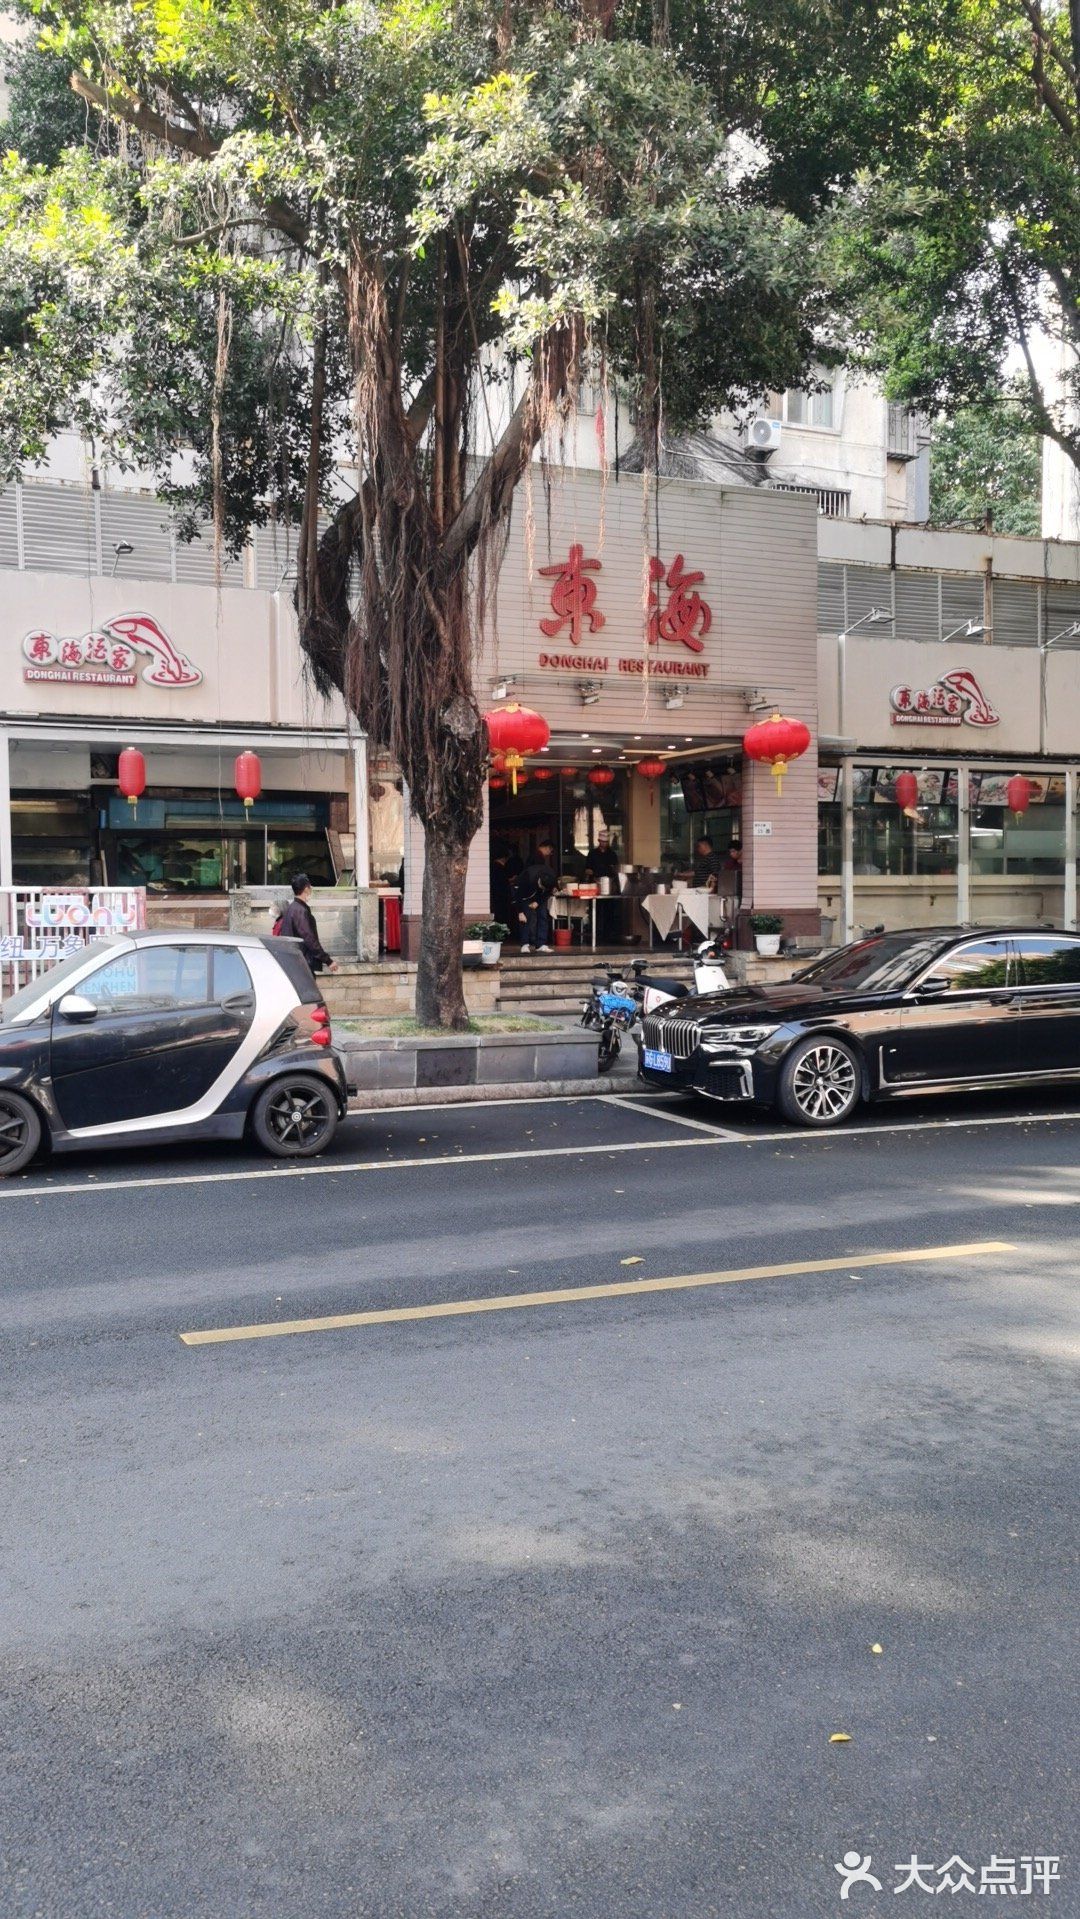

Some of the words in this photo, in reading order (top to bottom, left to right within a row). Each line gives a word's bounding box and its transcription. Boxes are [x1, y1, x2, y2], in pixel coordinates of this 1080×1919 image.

[539, 653, 609, 671] DONGHAI
[618, 657, 711, 677] RESTAURANT
[27, 670, 72, 681] DONGHAI
[73, 672, 135, 684] RESTAURANT
